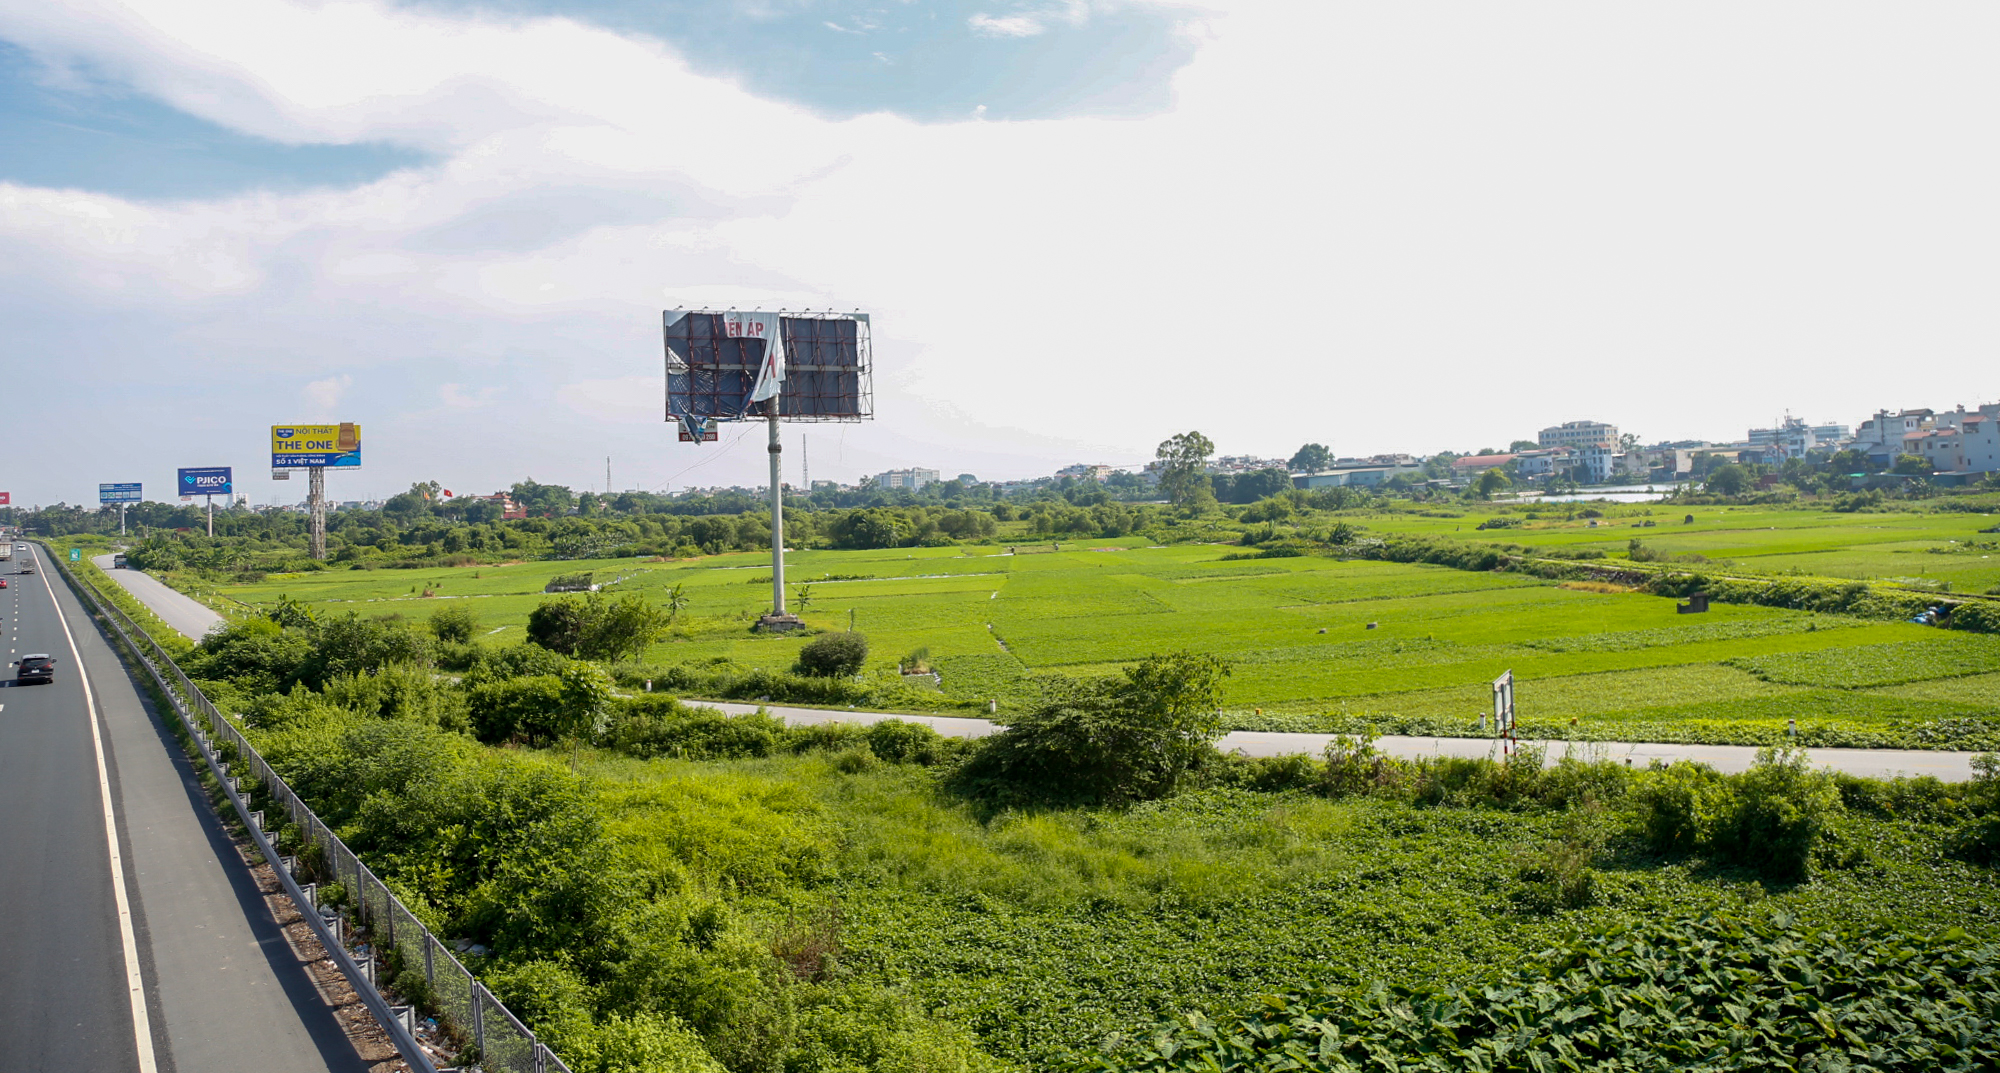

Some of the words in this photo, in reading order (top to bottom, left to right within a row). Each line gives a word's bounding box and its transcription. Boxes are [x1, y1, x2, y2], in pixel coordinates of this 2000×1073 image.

[747, 318, 763, 336] ÁP
[276, 441, 302, 450] THE
[306, 440, 333, 450] ONE
[197, 476, 226, 484] PJICO
